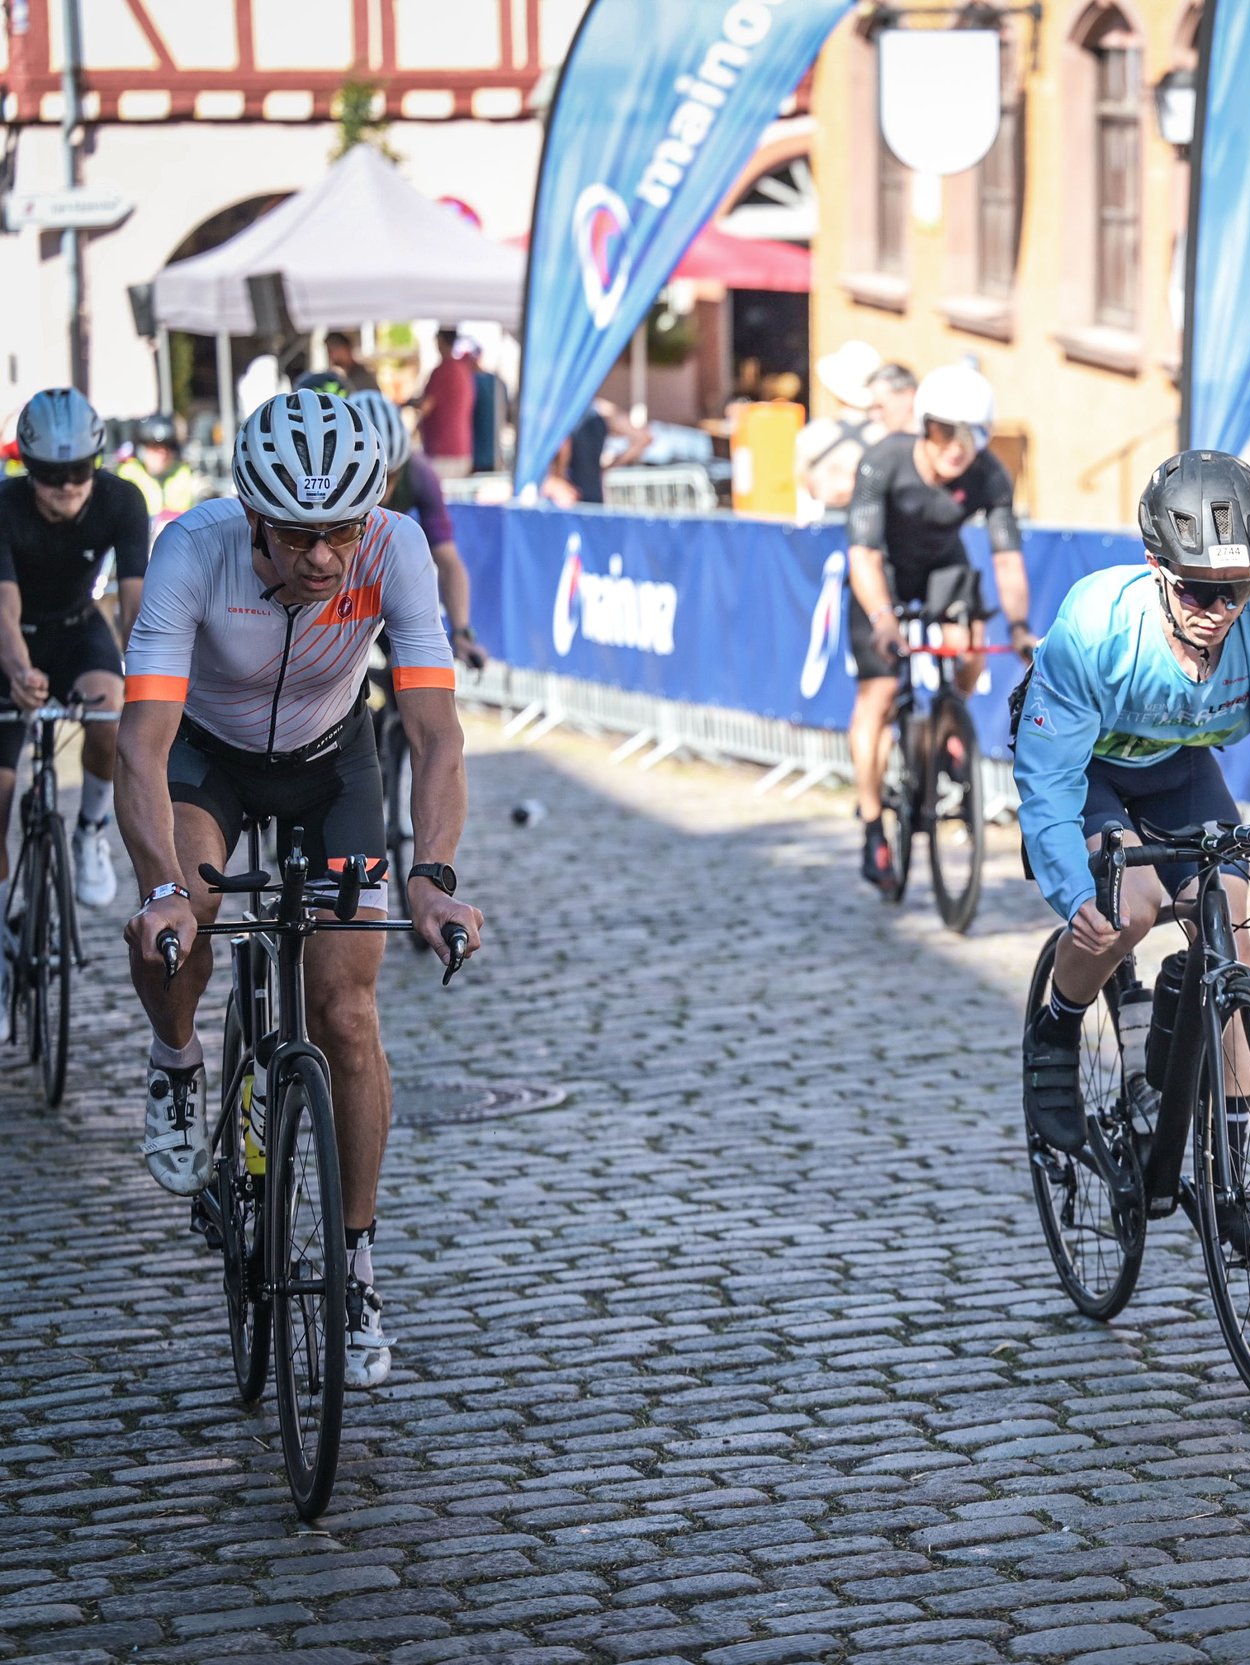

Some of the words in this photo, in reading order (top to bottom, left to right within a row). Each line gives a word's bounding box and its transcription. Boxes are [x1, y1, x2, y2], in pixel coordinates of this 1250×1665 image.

[636, 0, 784, 208] maino
[304, 477, 330, 490] 2770
[1216, 547, 1241, 557] 2744
[1118, 709, 1161, 724] ETTET
